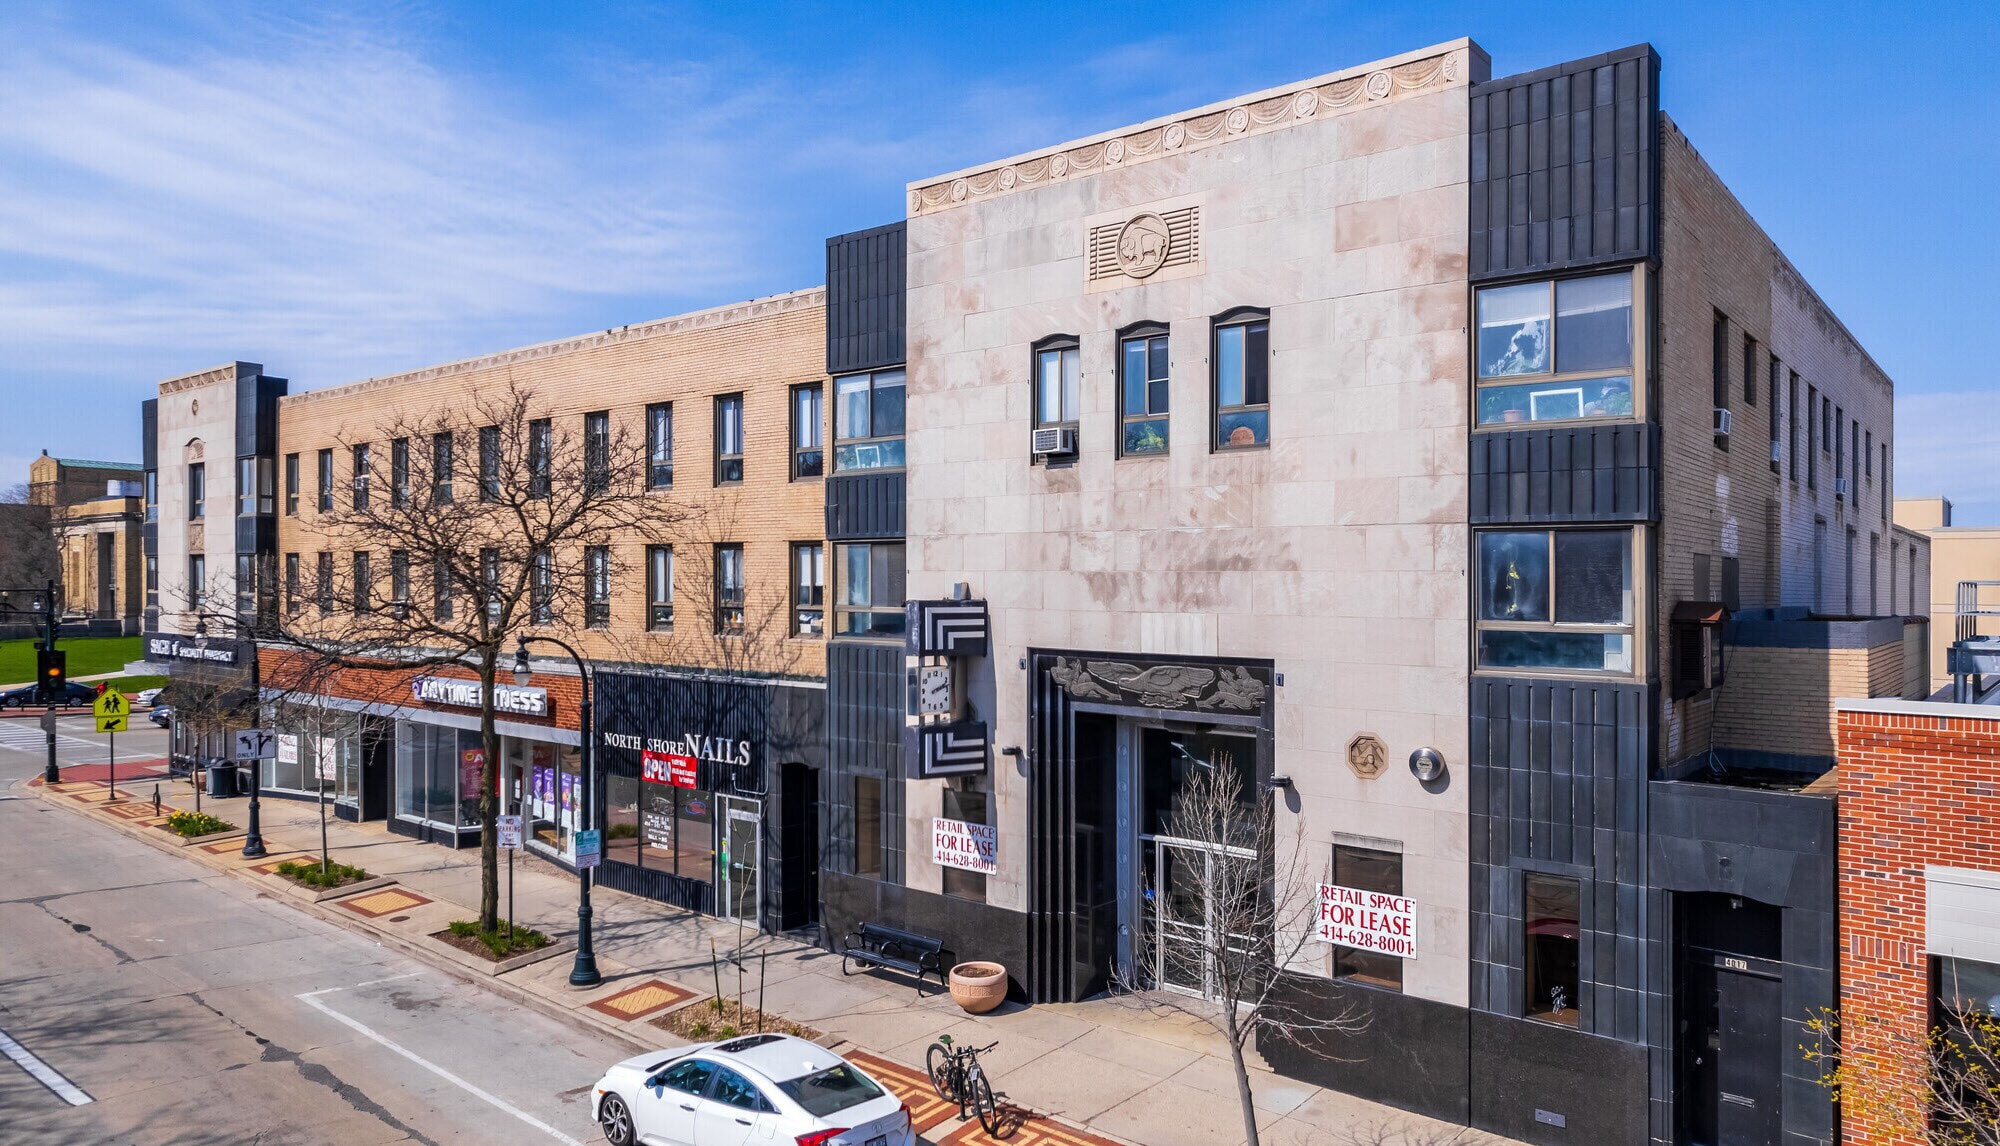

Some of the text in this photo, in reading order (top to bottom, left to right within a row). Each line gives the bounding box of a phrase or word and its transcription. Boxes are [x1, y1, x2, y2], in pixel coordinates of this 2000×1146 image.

[420, 681, 543, 712] ANYTIME TNESS
[604, 732, 642, 750] NORTH
[647, 738, 685, 757] SHORE
[684, 733, 750, 766] NAILS
[643, 757, 671, 782] OPEN
[577, 834, 582, 844] 2
[936, 819, 995, 839] RETAIL SPACE
[936, 833, 993, 857] FOR LEASE
[937, 850, 994, 871] 414-628-8001
[1321, 885, 1411, 914] RETAIL SPACE
[1321, 903, 1411, 937] FOR LEASE
[1320, 924, 1412, 955] 414-628-8001
[1727, 959, 1745, 969] 4017
